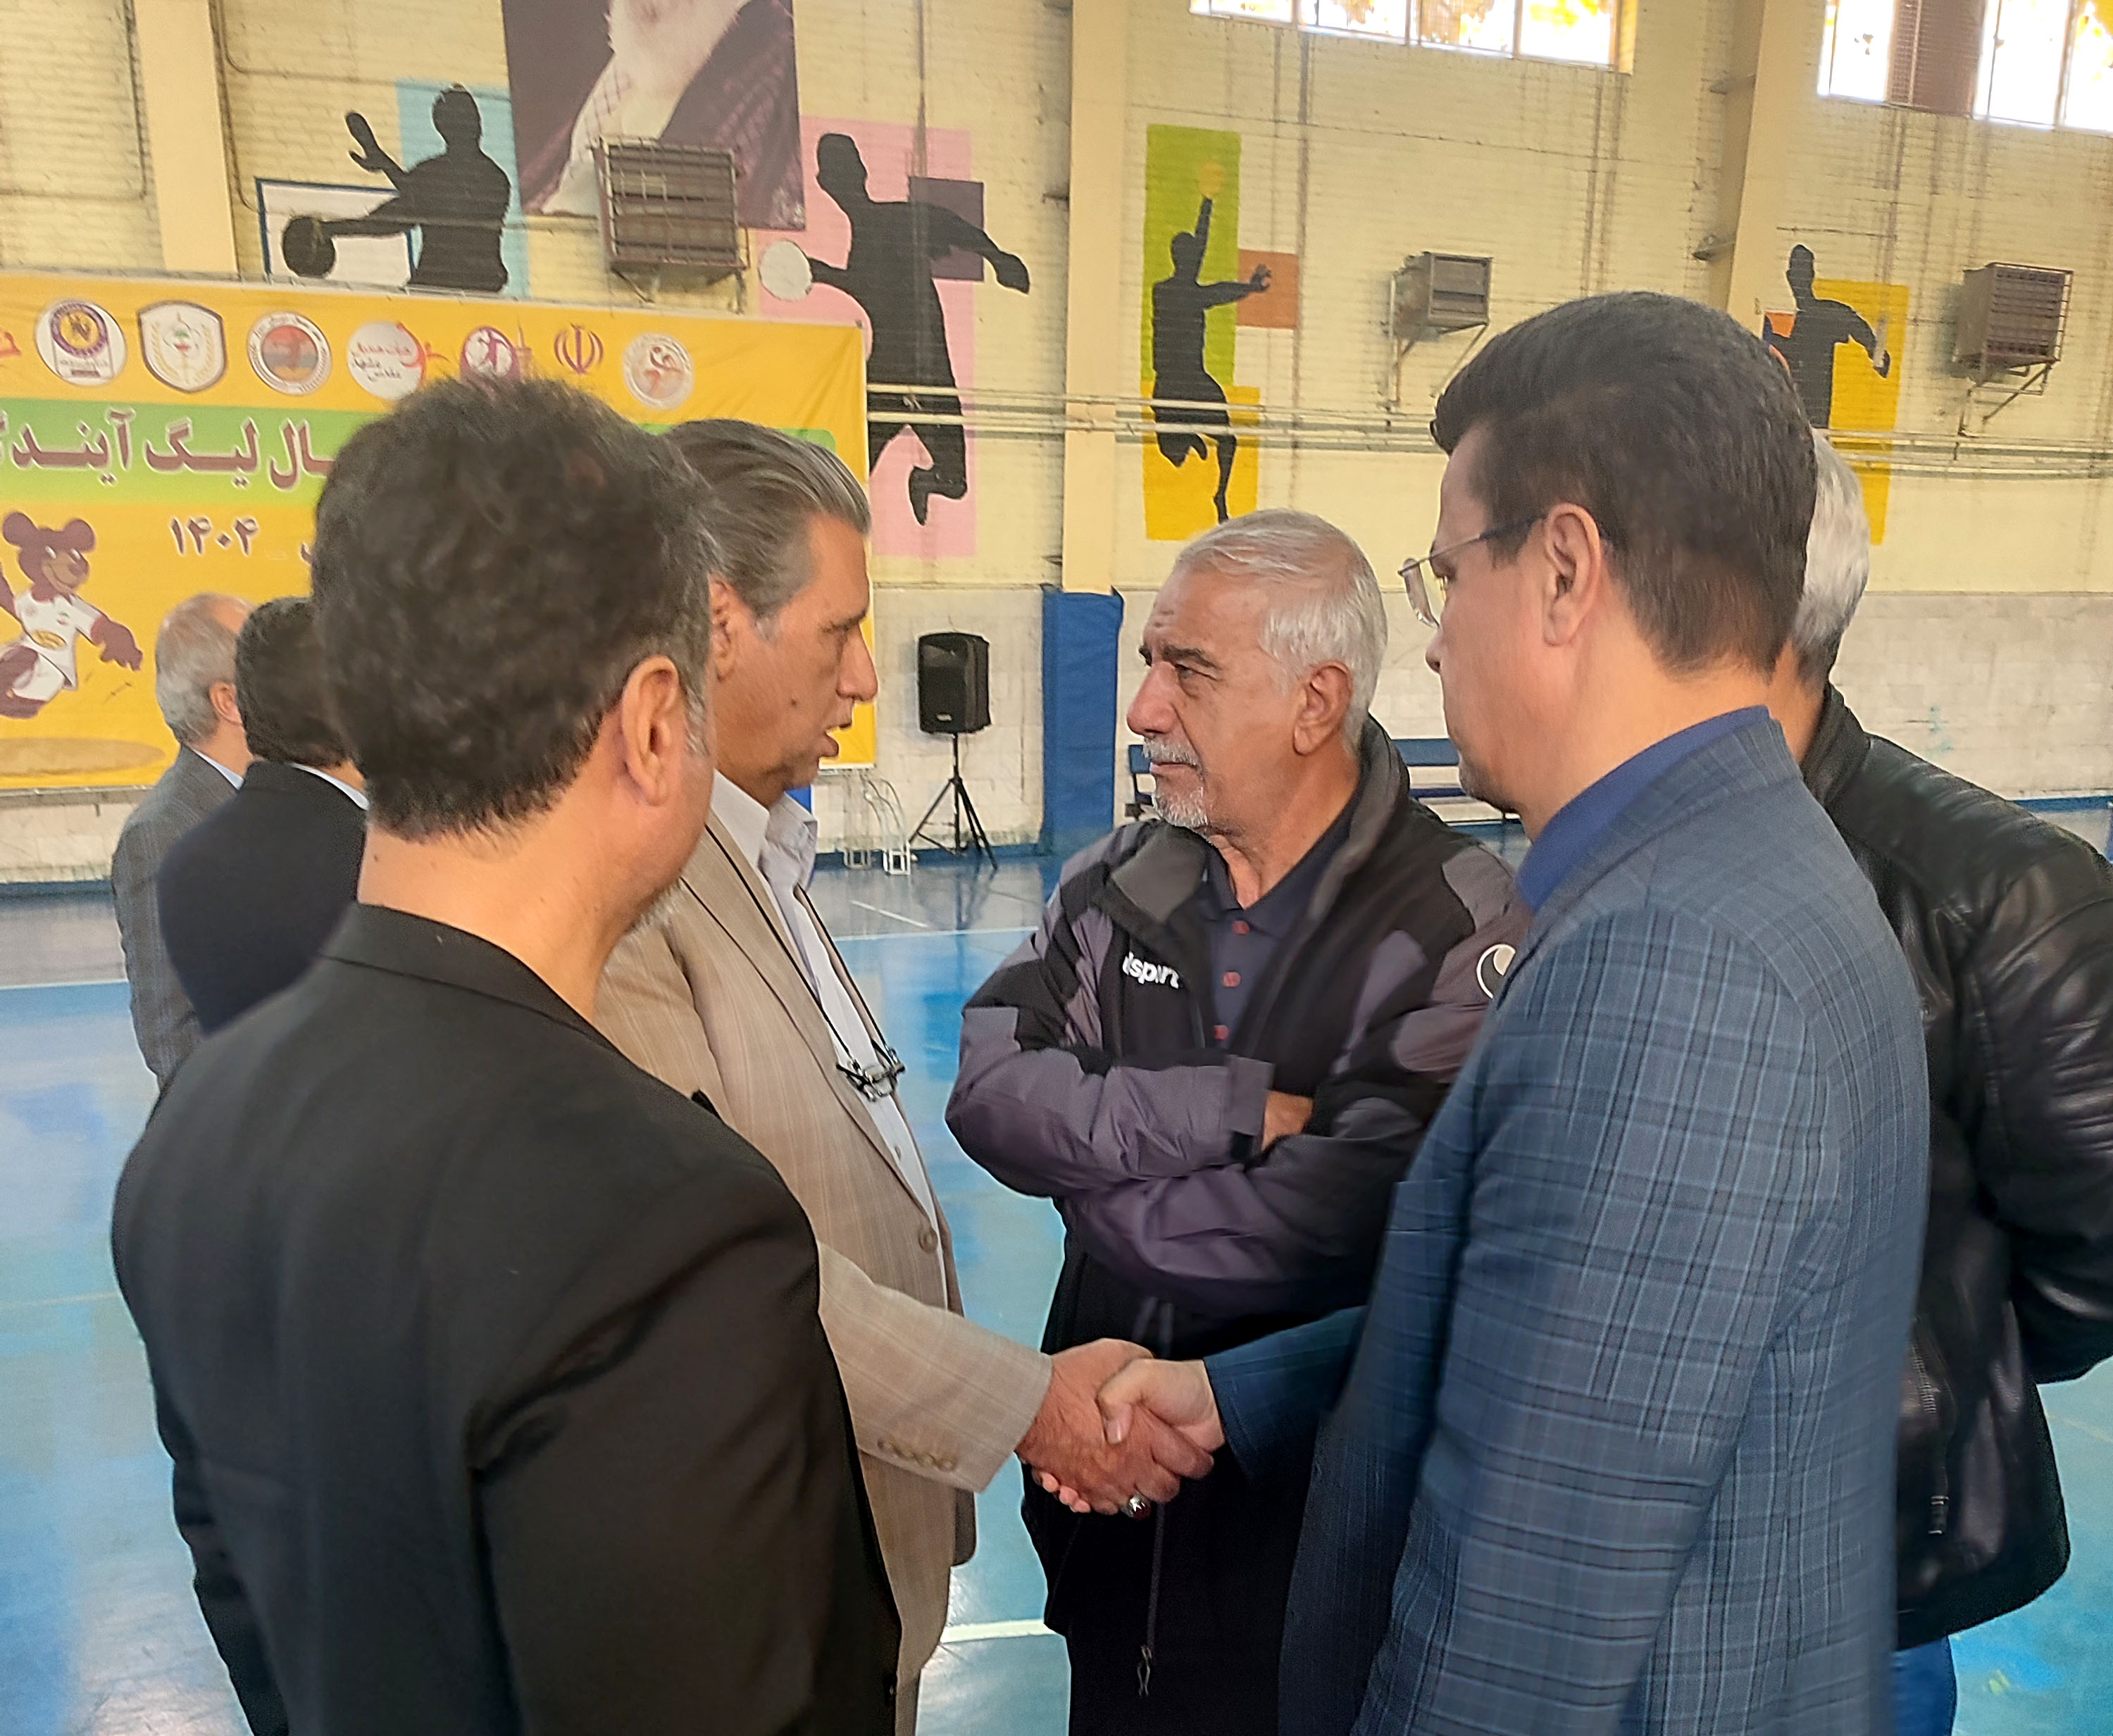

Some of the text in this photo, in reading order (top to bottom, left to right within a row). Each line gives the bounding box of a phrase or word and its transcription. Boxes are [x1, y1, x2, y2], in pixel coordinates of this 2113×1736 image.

[0, 407, 135, 486] آیند
[143, 416, 258, 489] لیگ
[170, 516, 258, 556] ۱۴۰۴
